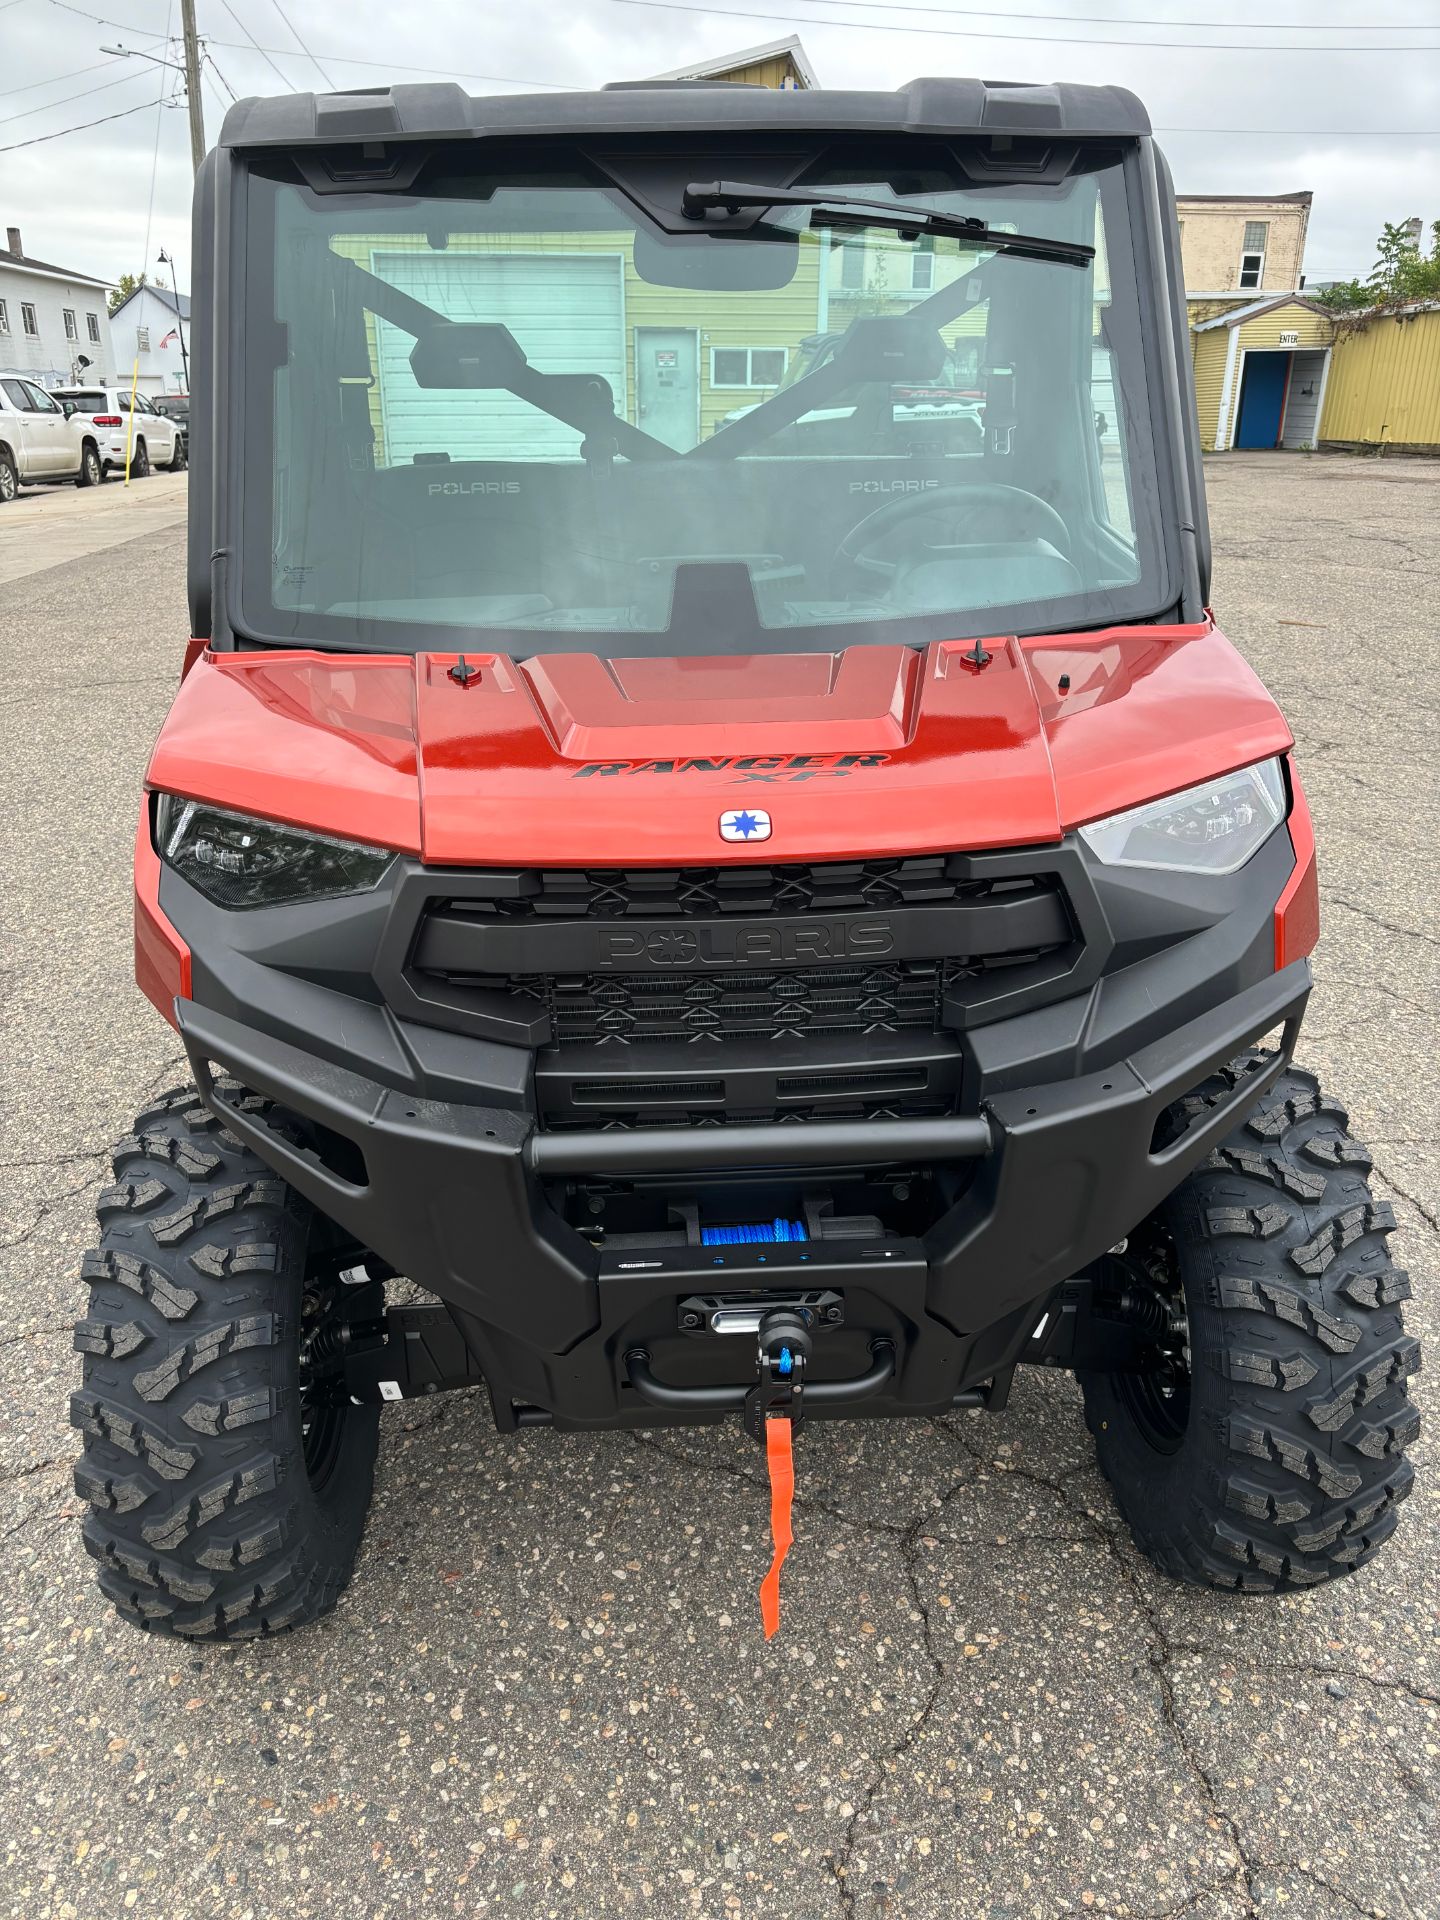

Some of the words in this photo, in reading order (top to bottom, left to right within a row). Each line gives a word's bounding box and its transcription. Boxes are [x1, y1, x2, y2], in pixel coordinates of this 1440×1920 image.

[1280, 334, 1298, 343] ENTER
[428, 481, 521, 496] POLARIS
[570, 752, 890, 778] RANGER
[721, 769, 853, 784] XP
[598, 919, 895, 965] POLARIS
